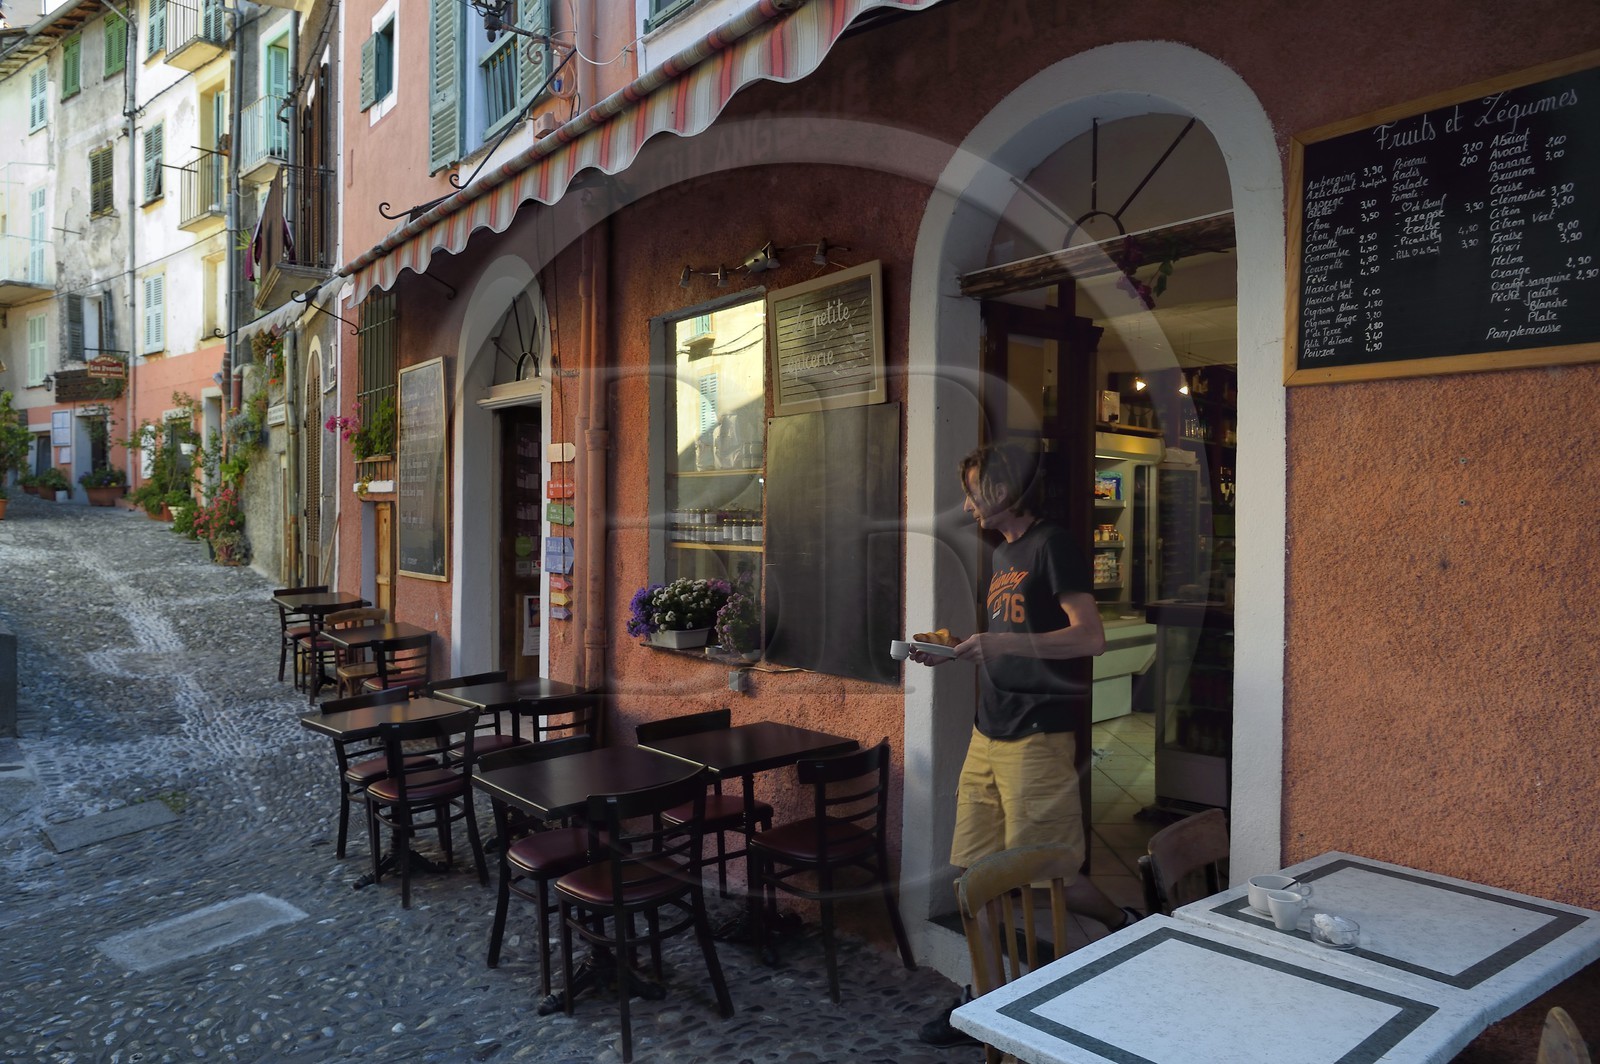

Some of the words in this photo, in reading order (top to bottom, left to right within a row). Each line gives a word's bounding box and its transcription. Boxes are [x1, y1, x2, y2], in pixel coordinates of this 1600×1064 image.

[1373, 114, 1437, 150] Fruits
[1445, 105, 1463, 133] et
[1474, 88, 1578, 133] Légumes
[1490, 128, 1530, 148] Abricot
[1489, 141, 1528, 160] Avocat
[1488, 155, 1532, 172] Banane
[1307, 171, 1355, 191] Aubergine
[1392, 167, 1420, 181] Radis
[1306, 179, 1356, 200] Artichaut
[1392, 177, 1429, 193] Salade
[1490, 182, 1523, 195] Cerise
[1305, 197, 1344, 212] Asperge
[1489, 205, 1520, 219] Citron
[1307, 219, 1330, 233] Chou
[1405, 210, 1445, 229] grappe
[1490, 218, 1525, 231] Citron
[1491, 229, 1523, 243] Fraise
[1305, 239, 1338, 254] Carotte
[1491, 242, 1521, 255] Kiwi
[1305, 248, 1350, 263] Concombre
[1491, 254, 1524, 266] Melon
[1305, 259, 1343, 275] Courgette
[1491, 267, 1531, 280] Orange
[1305, 281, 1337, 295] Haricot
[1491, 278, 1524, 292] Orange
[1306, 294, 1334, 306] Haricot
[1529, 298, 1568, 311] Blanche
[812, 298, 850, 338] petite
[1335, 314, 1357, 328] Rouge
[1528, 310, 1558, 322] Plate
[1486, 325, 1562, 342] Pamplemousse
[1303, 348, 1335, 359] Poivron
[1003, 593, 1025, 623] 76
